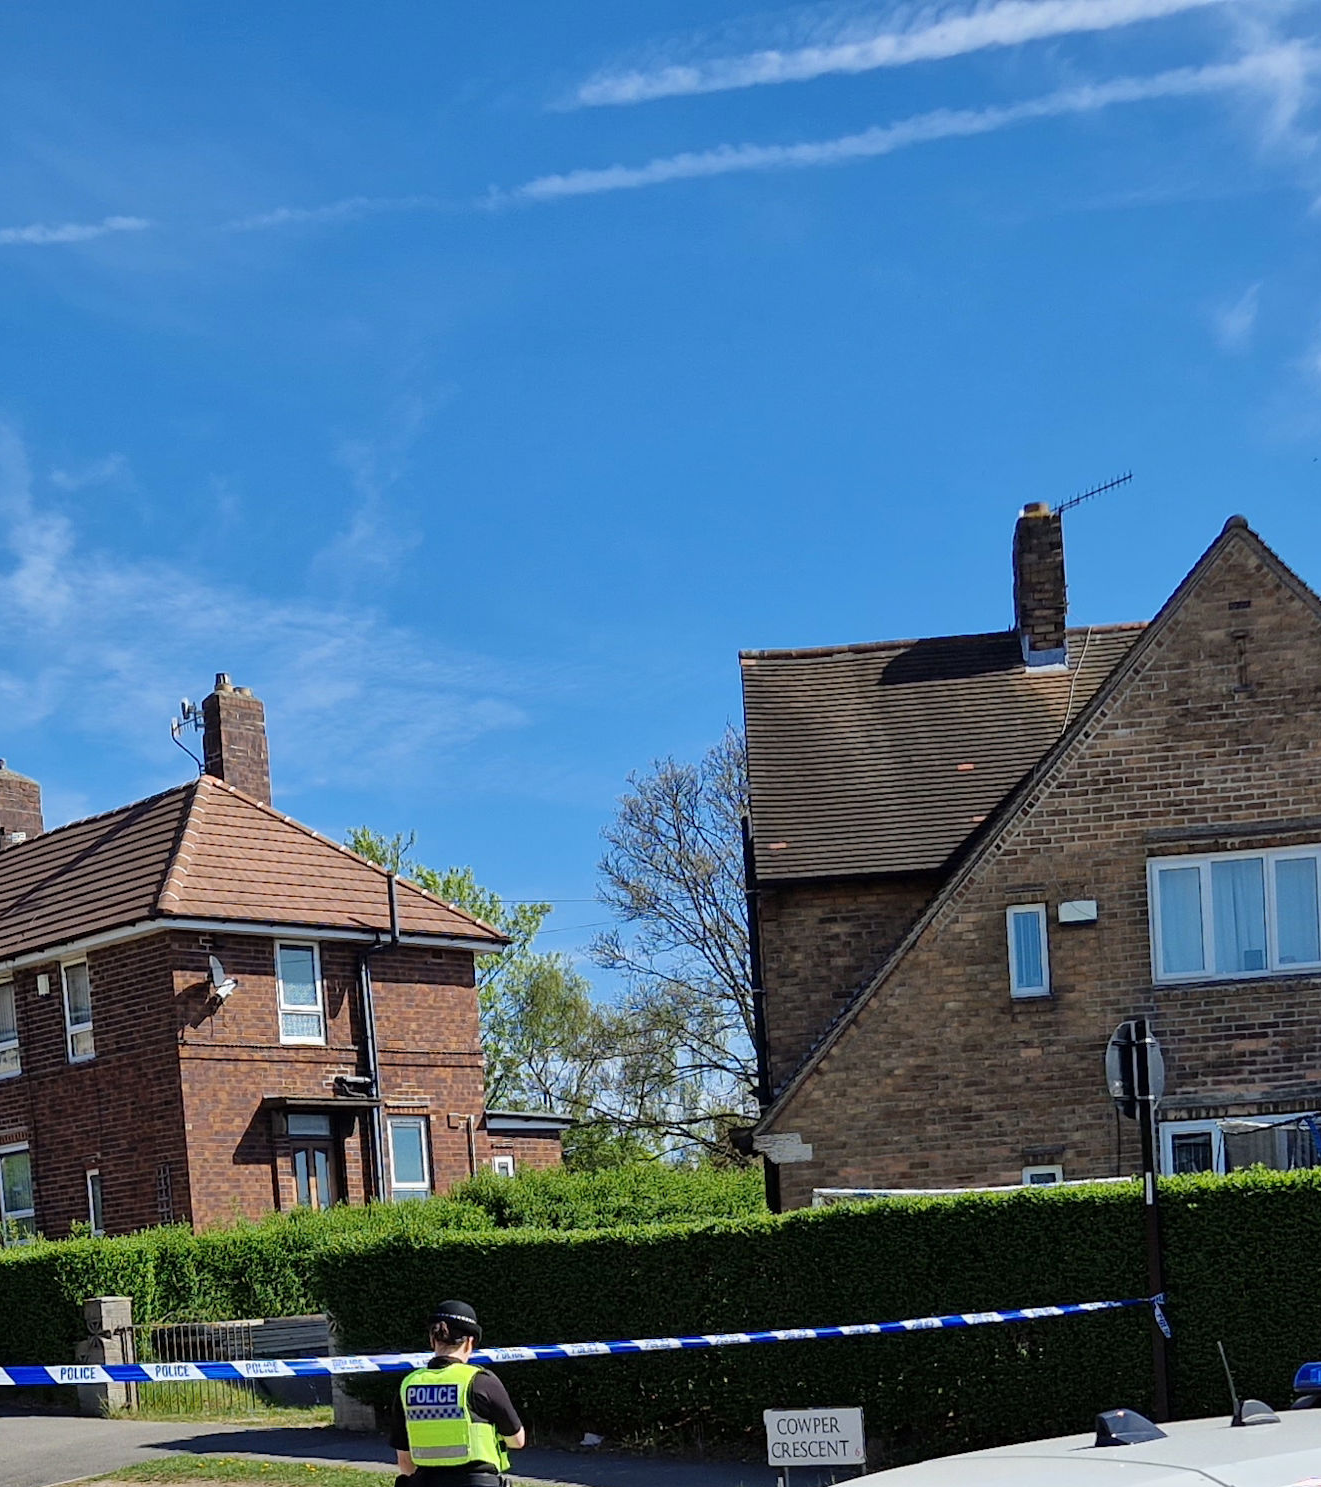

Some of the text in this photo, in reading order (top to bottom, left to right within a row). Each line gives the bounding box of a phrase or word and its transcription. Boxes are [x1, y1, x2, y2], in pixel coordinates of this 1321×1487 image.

[60, 1366, 96, 1381] POLICE
[154, 1364, 190, 1378] POLICE
[245, 1360, 280, 1375] POLICE
[407, 1386, 457, 1405] POLICE
[777, 1417, 840, 1435] COWPER
[771, 1440, 850, 1458] CRESCENT
